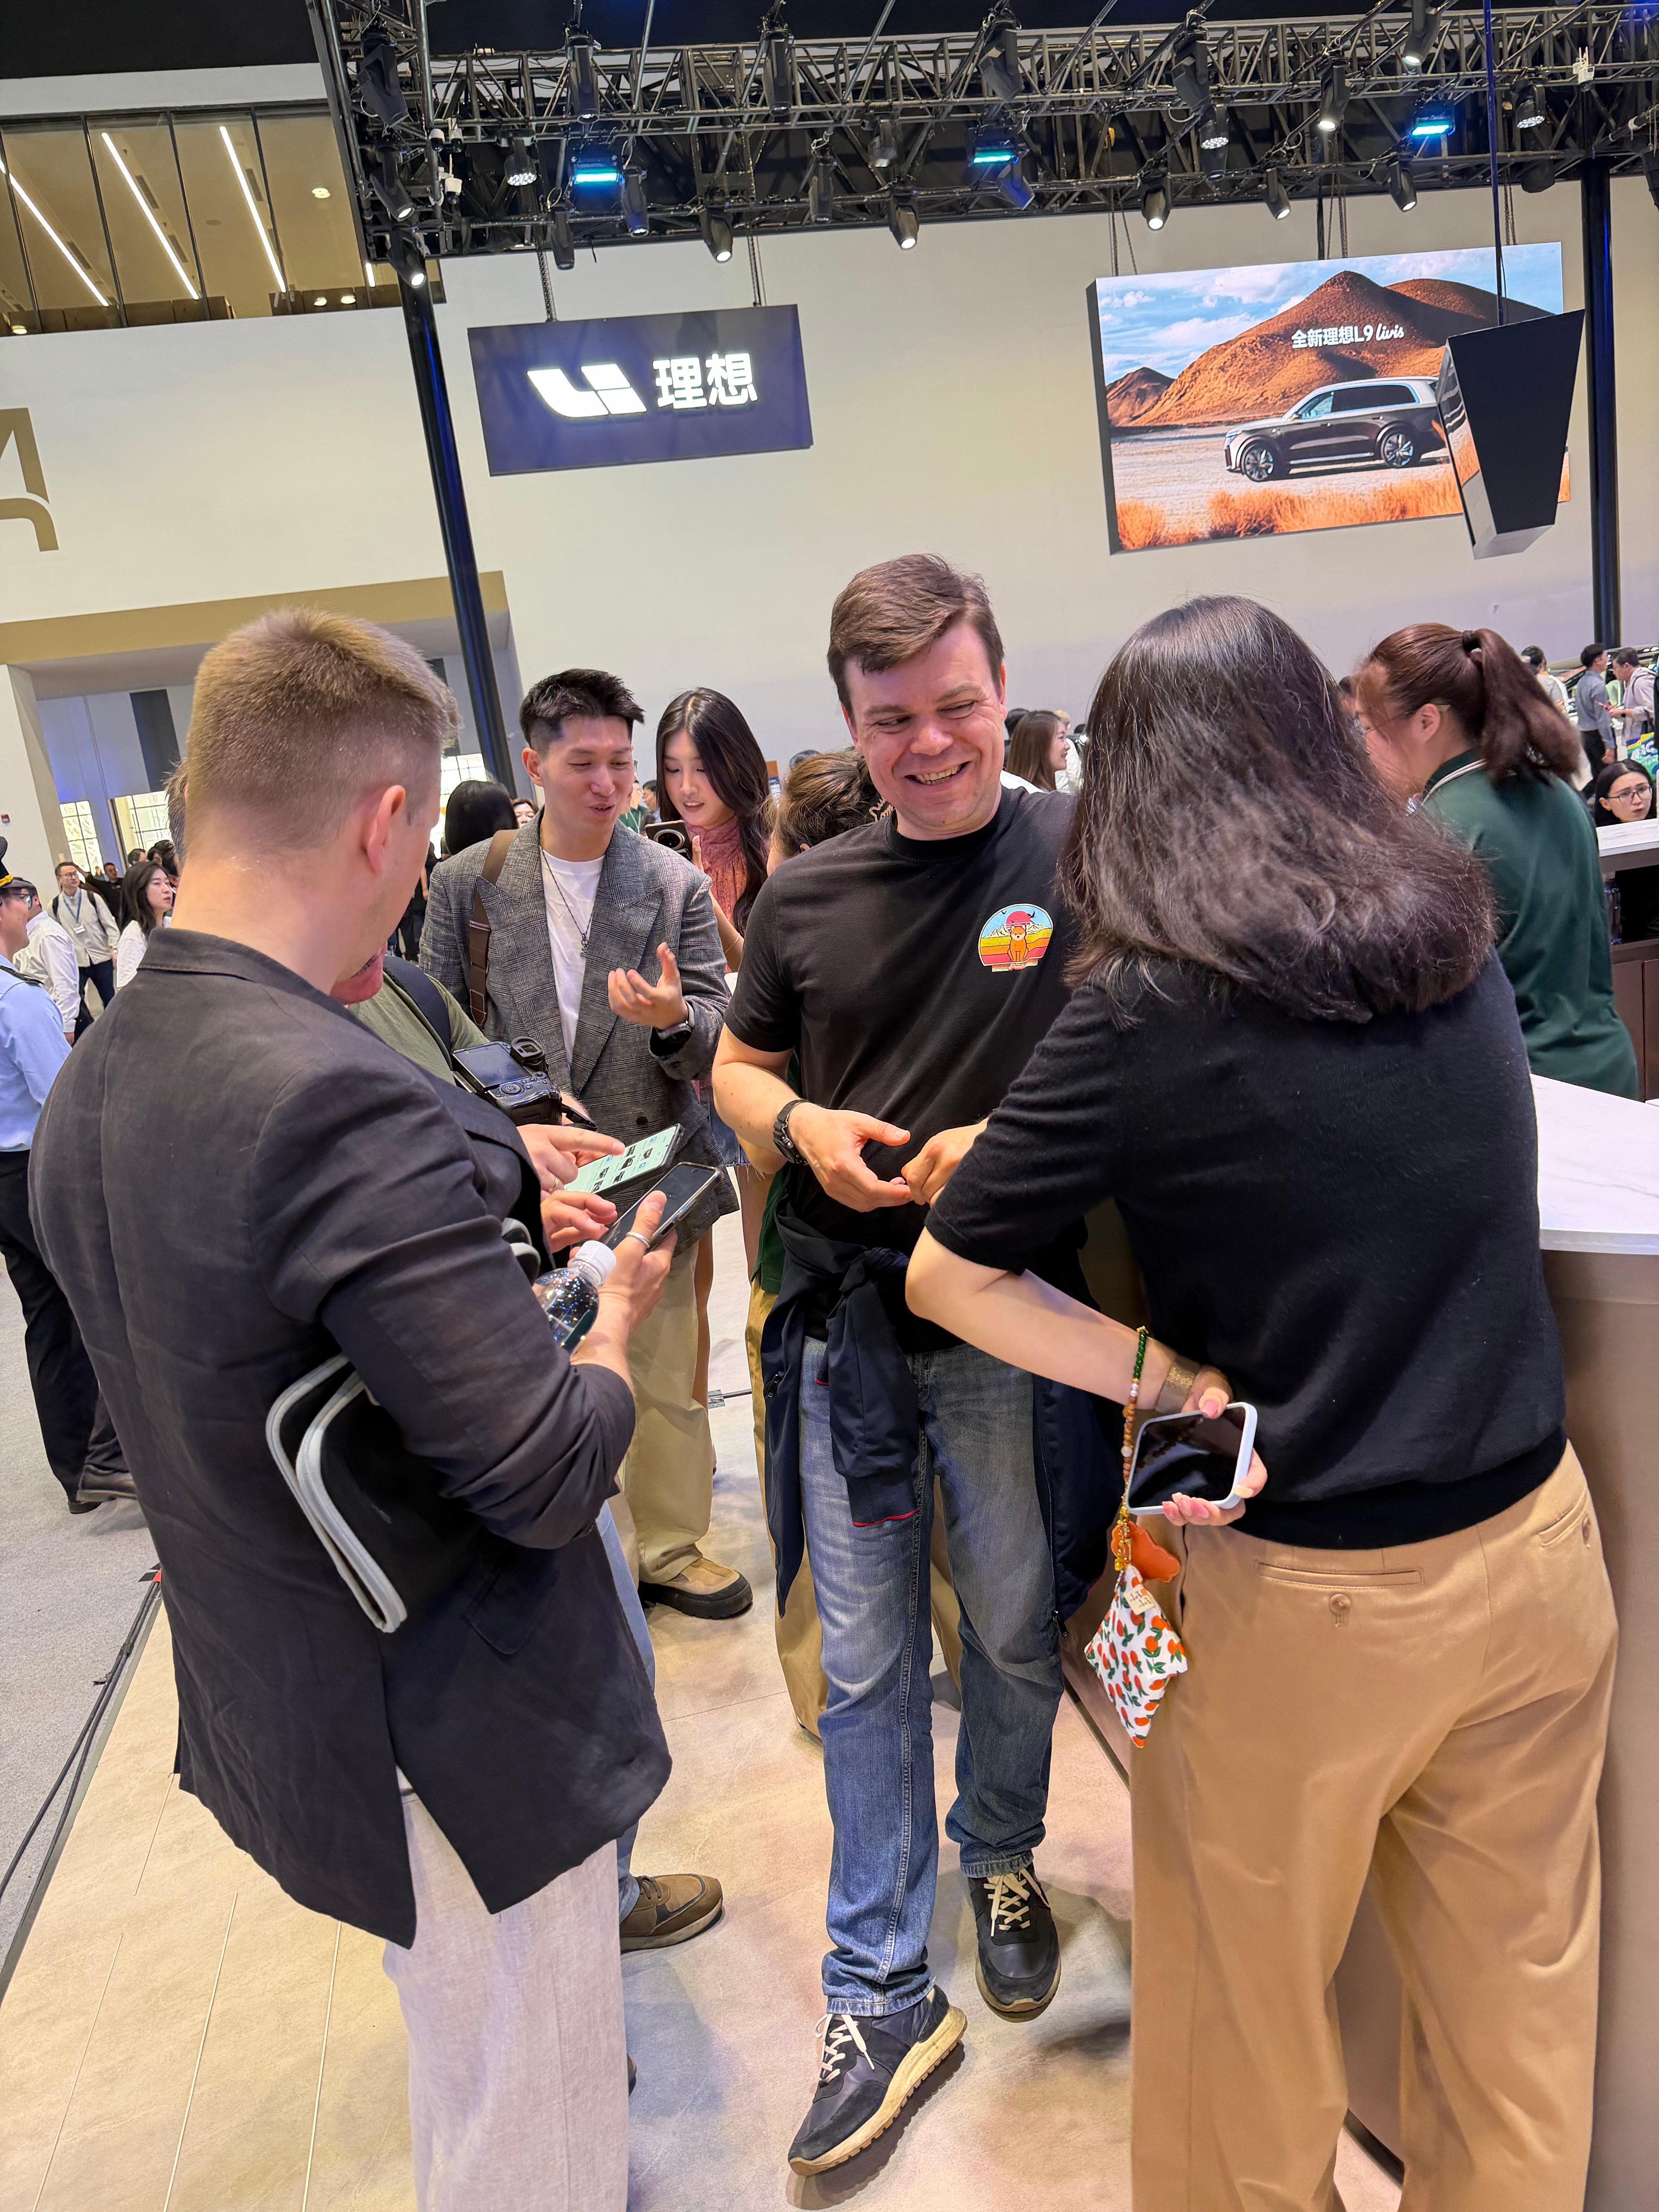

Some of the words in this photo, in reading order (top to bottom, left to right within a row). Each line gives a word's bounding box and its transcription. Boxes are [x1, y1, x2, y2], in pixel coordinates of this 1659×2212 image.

[1291, 325, 1374, 349] 全新理想L9
[653, 353, 758, 409] 理想
